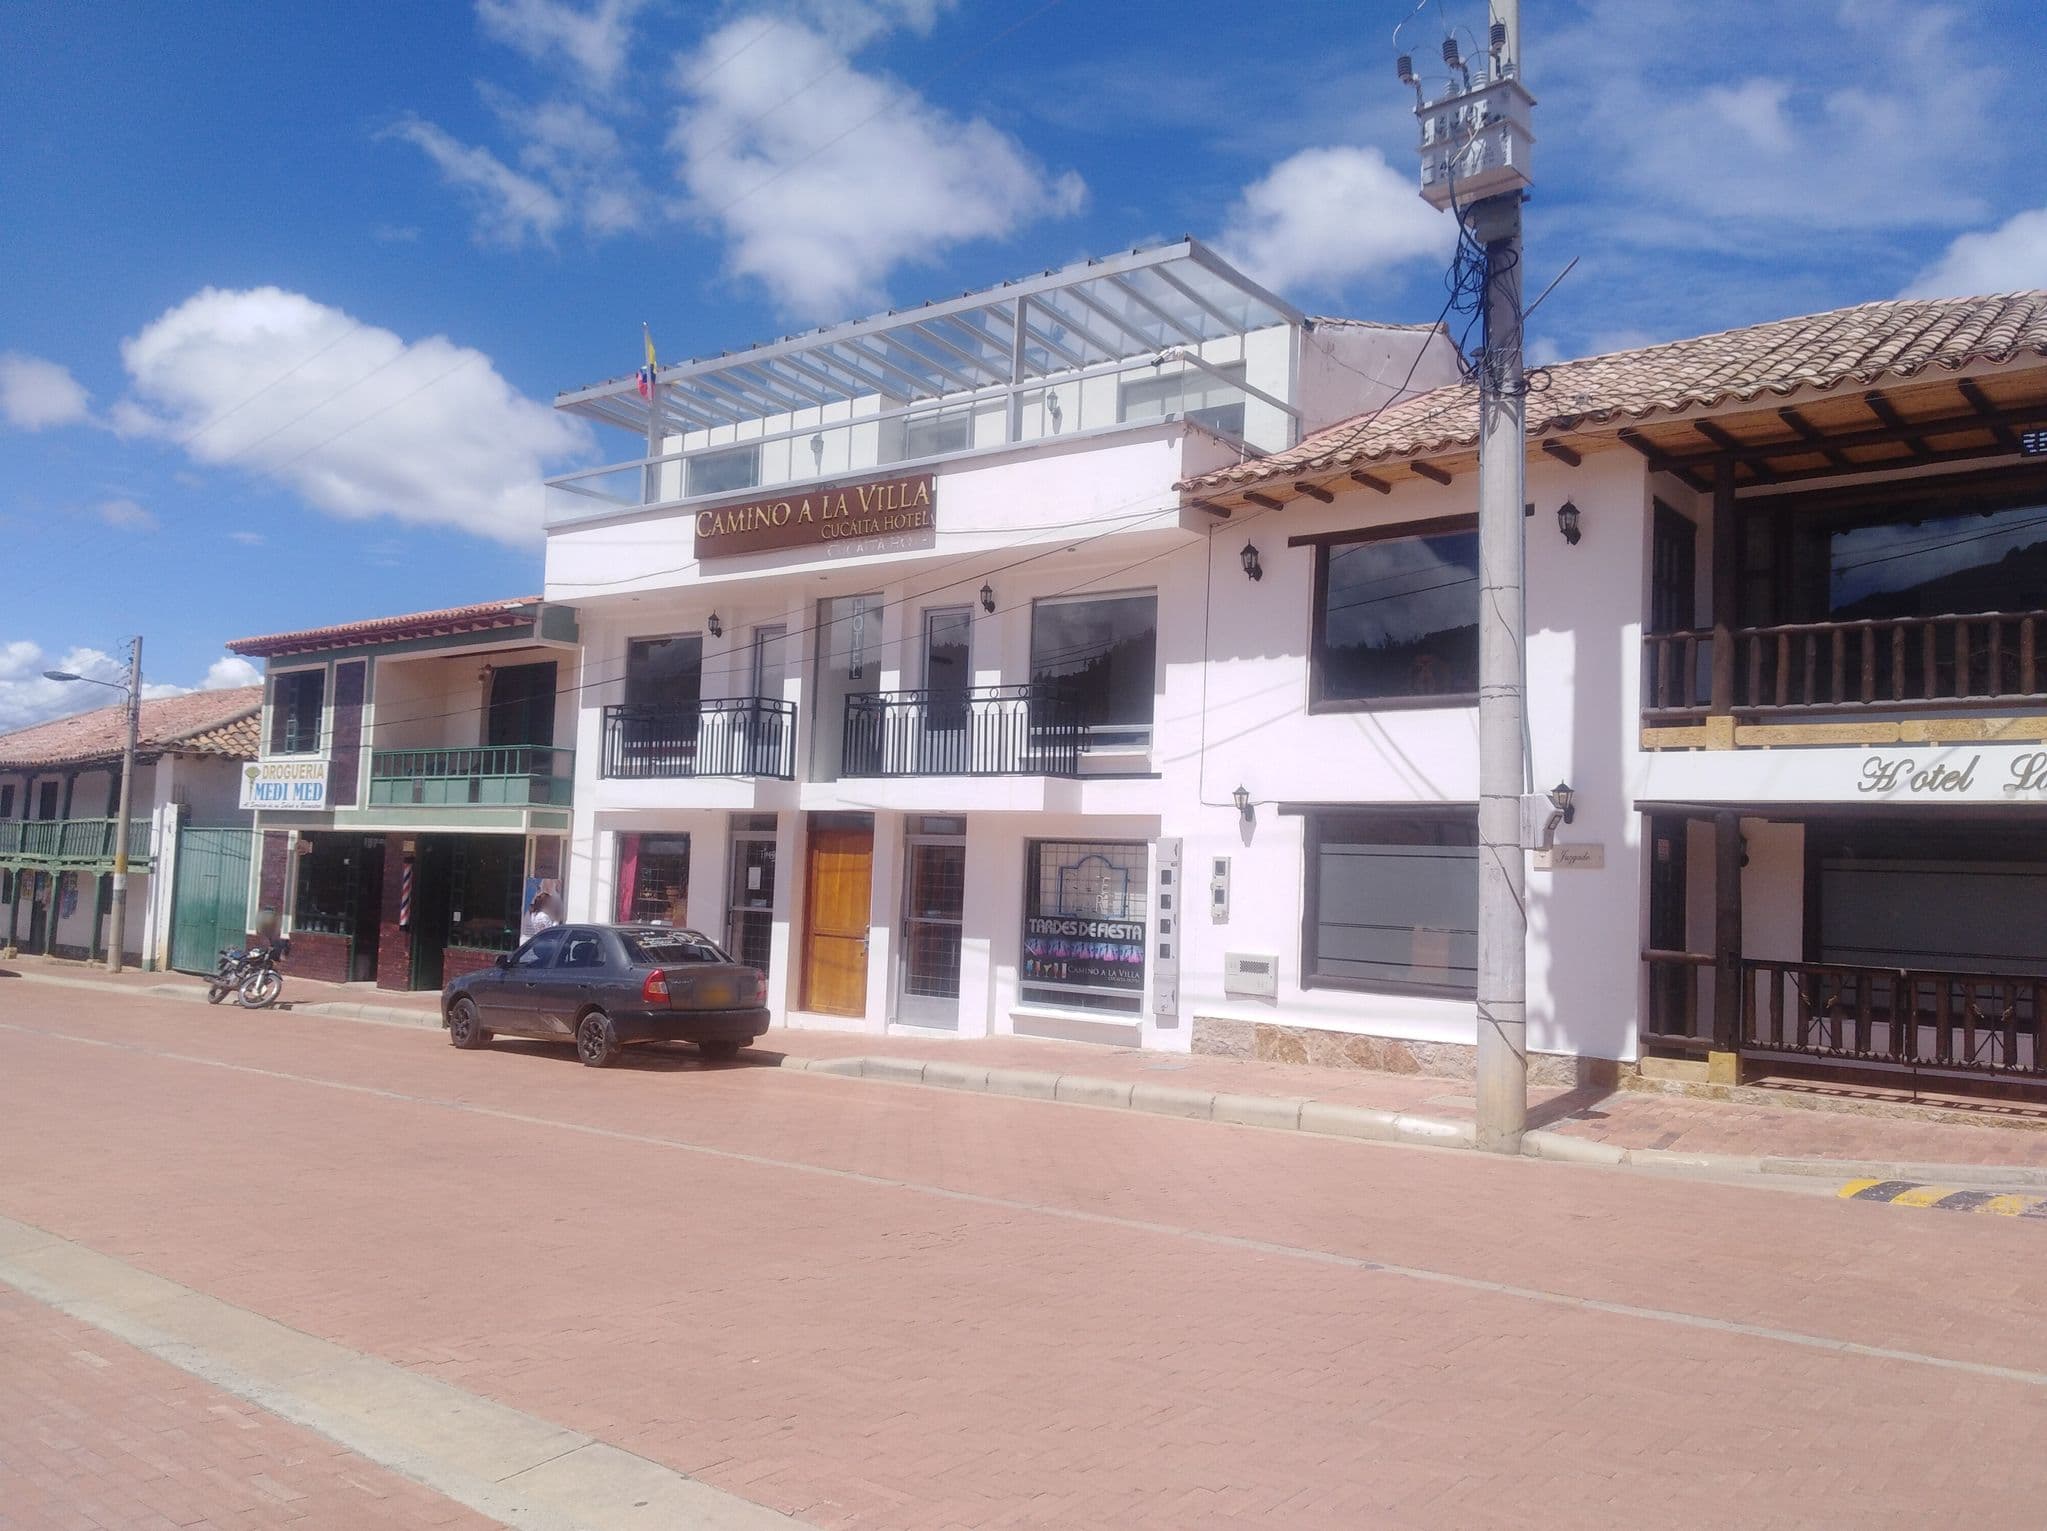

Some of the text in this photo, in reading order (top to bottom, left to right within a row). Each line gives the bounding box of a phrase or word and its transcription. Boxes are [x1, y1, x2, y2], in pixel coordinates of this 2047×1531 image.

[696, 480, 931, 538] CAMINO A LA VILLA
[884, 510, 930, 531] HOTEL
[262, 763, 324, 780] DROGUERIA
[1857, 754, 1981, 793] Hotel
[254, 782, 324, 801] MEDI MED
[1029, 917, 1142, 941] TARDES DE FIESTA
[1067, 965, 1100, 977] CAMINO
[1108, 968, 1117, 977] LA
[1119, 968, 1140, 979] VILLA
